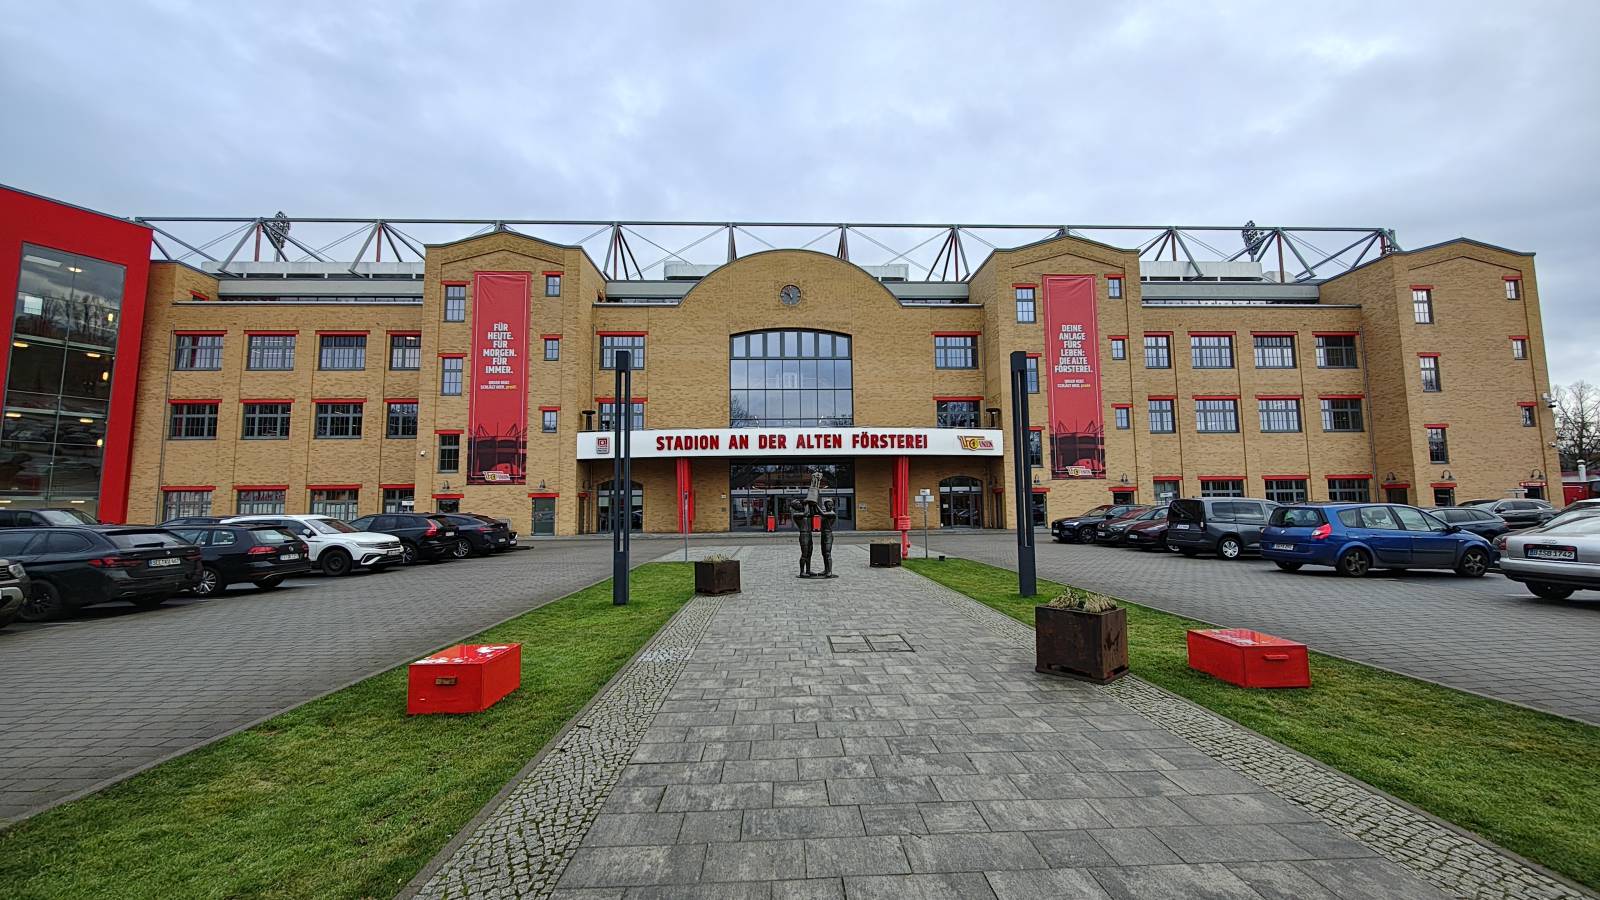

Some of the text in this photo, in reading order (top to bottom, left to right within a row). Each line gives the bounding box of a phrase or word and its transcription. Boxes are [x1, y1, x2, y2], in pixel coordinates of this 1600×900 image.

[494, 322, 508, 331] FÜR
[488, 332, 514, 340] HEUTE.
[493, 340, 508, 348] FÜR
[1064, 340, 1082, 348] FÜRS
[482, 349, 517, 357] MORGEN.
[492, 356, 508, 365] FÜR
[485, 366, 514, 374] IMMER.
[1054, 364, 1094, 373] FÖRSTEREI.
[656, 432, 928, 451] STADION AN DER ALTEN FÖRSTEREI
